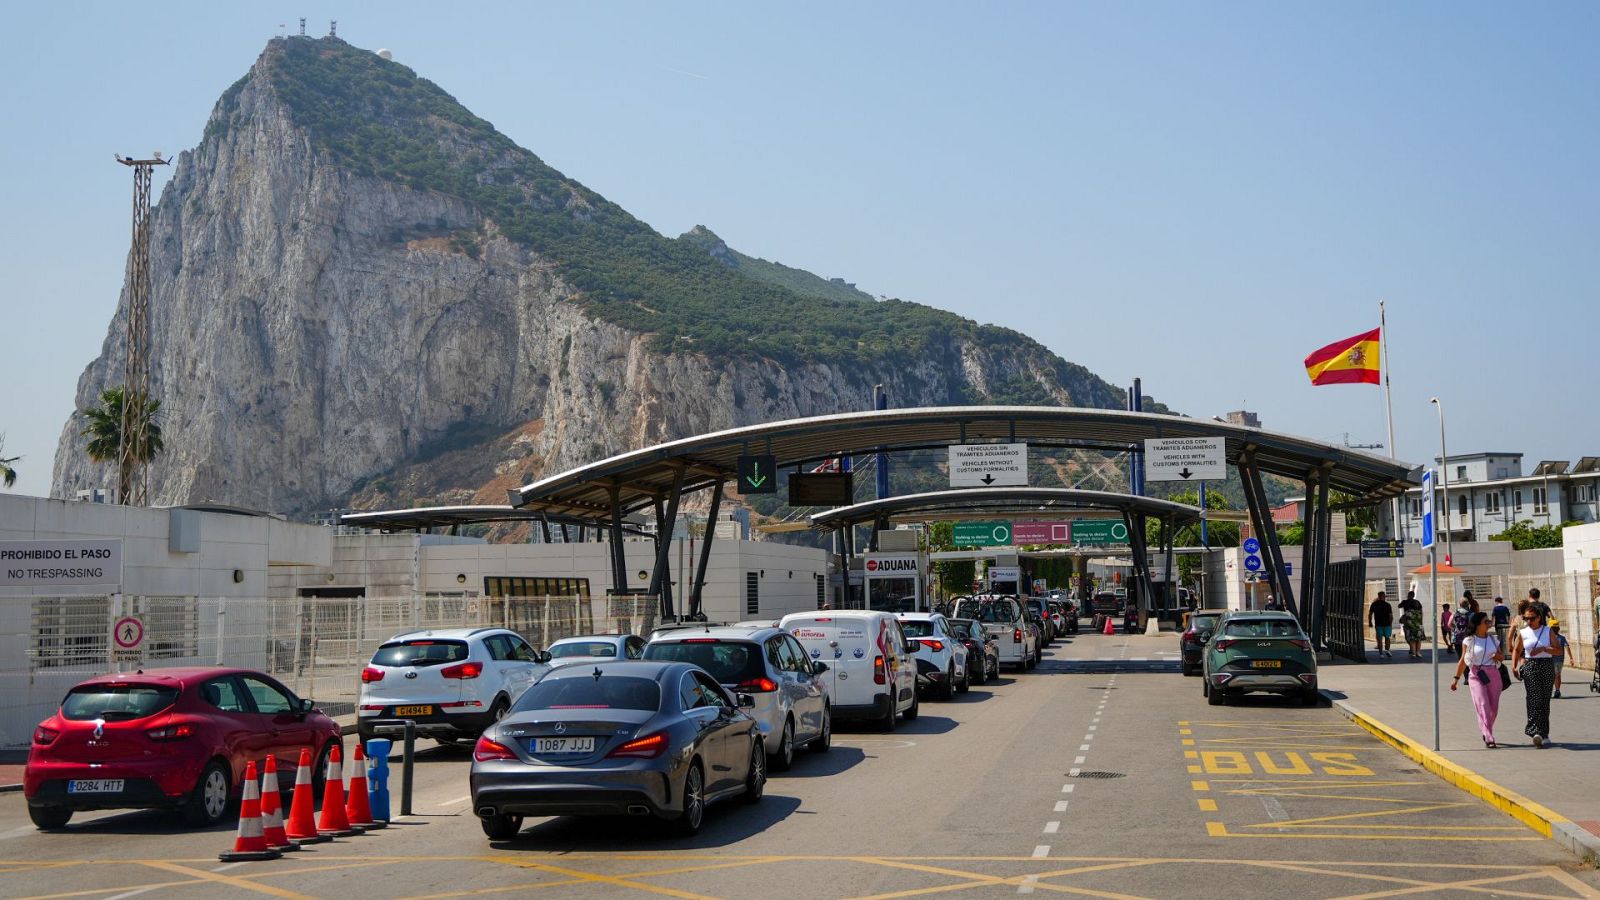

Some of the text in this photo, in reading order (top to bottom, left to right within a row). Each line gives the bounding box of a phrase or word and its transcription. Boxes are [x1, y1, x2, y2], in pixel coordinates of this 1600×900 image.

[0, 549, 111, 560] PROHIBIDO EL PASO
[878, 560, 916, 570] ADUANA
[8, 568, 102, 578] NO TRESPASSING
[540, 739, 592, 751] 1087 JJJ
[1201, 752, 1376, 776] BUS
[76, 780, 121, 791] 0284 HTT
